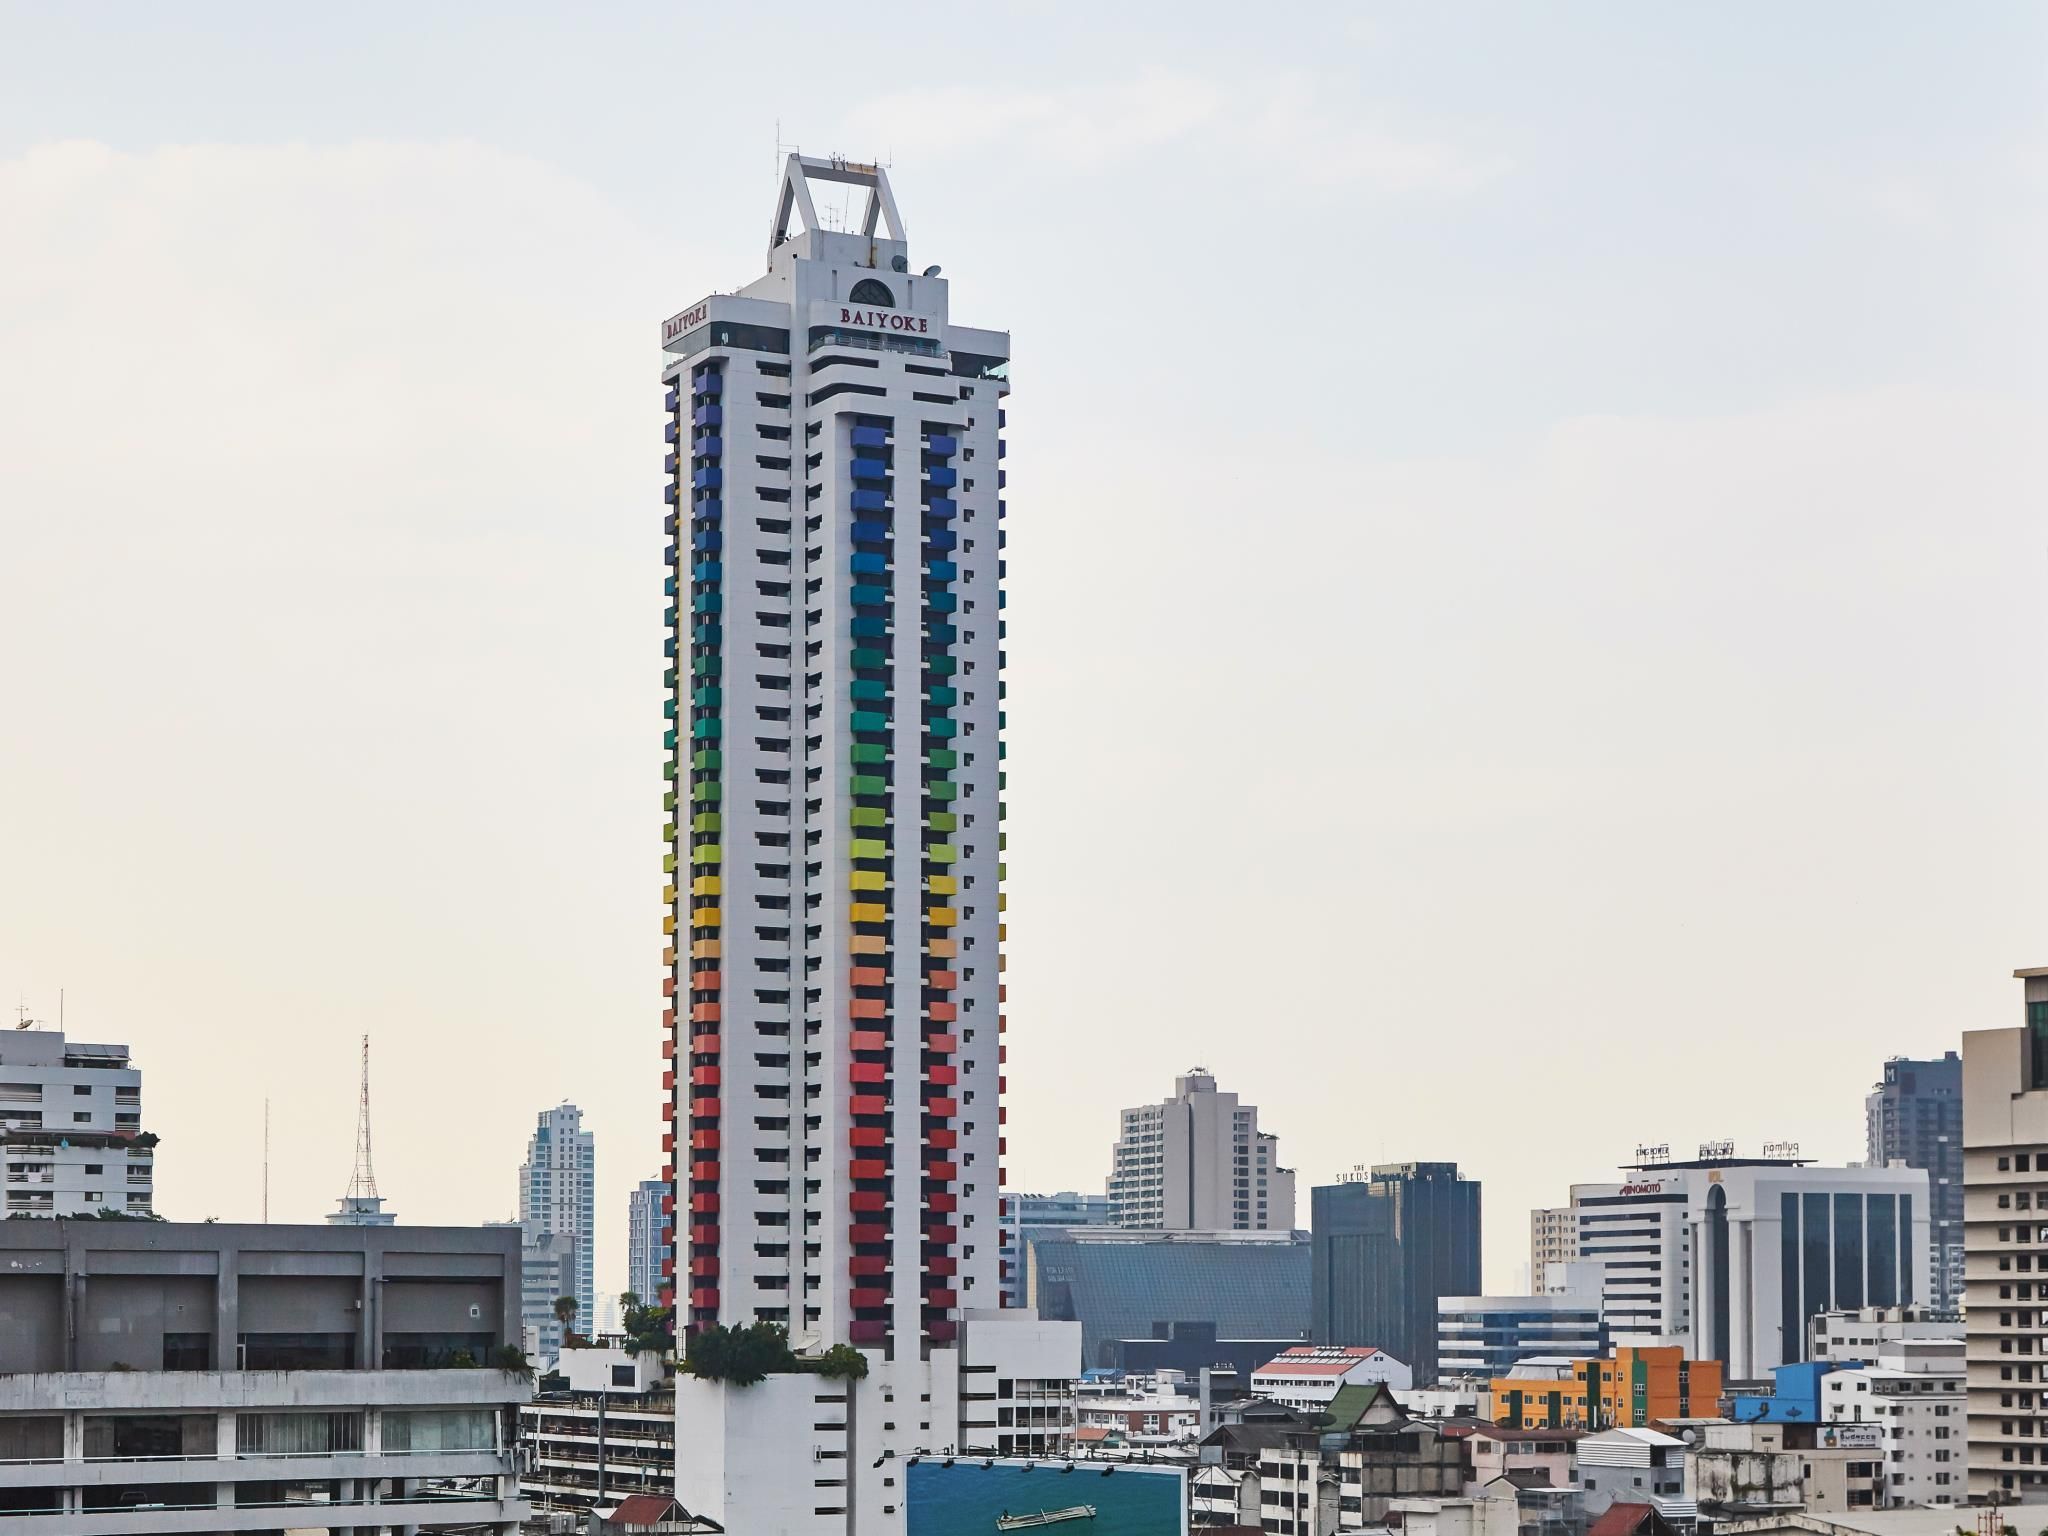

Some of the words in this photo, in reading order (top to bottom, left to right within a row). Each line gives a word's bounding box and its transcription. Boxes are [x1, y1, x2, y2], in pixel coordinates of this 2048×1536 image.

[667, 304, 707, 339] BAIYOKE
[841, 308, 928, 332] BAIYOKE
[1619, 1183, 1661, 1196] AJINOMOTO
